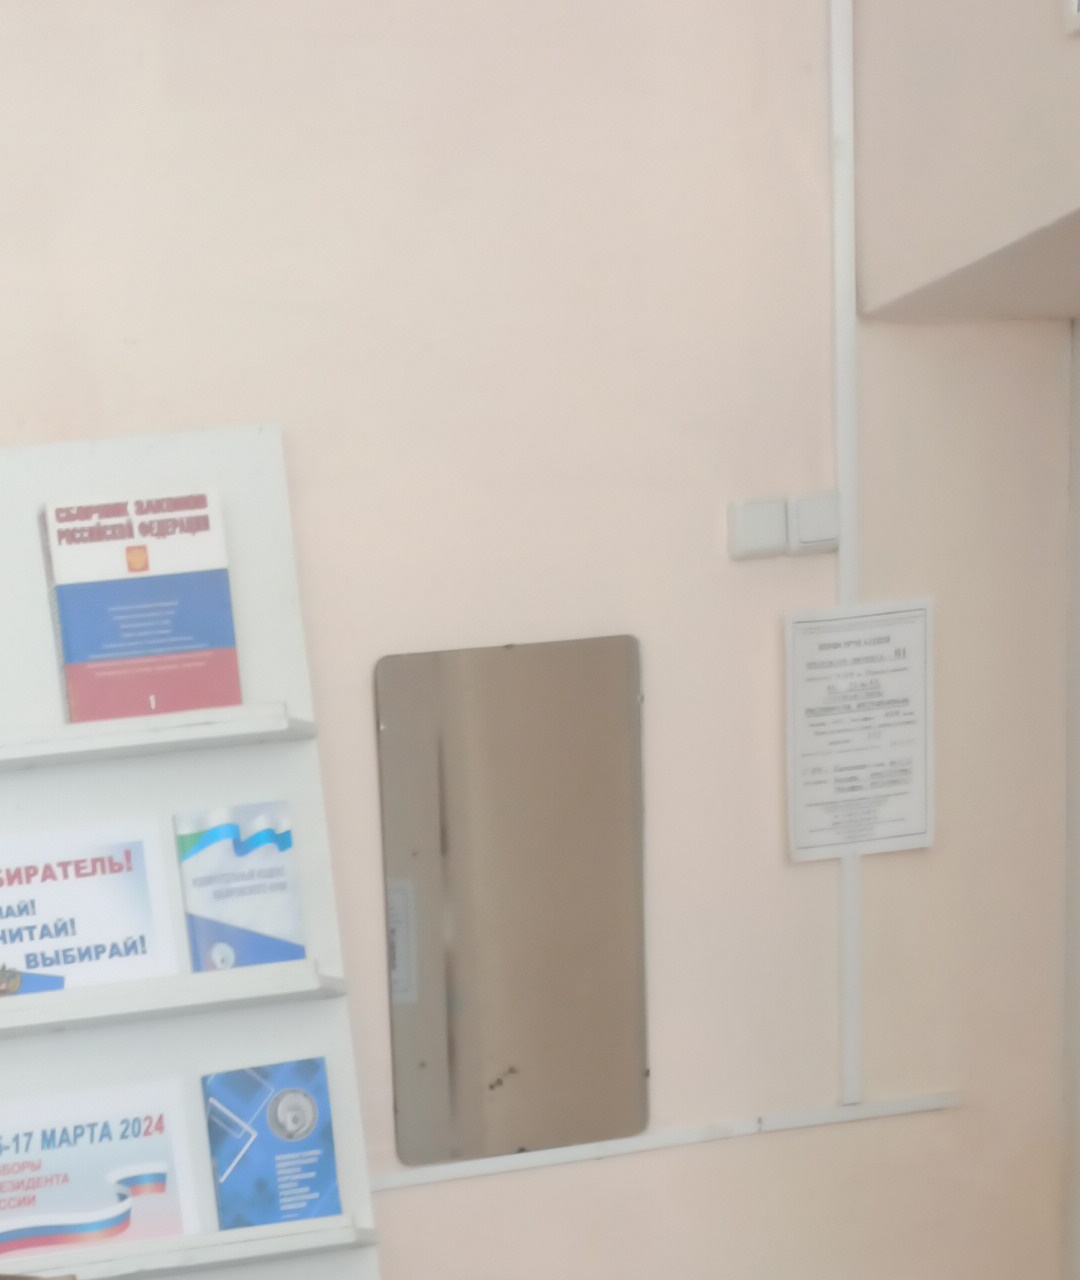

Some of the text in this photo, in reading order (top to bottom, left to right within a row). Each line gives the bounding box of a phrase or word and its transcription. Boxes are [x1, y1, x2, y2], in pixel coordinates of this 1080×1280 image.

[24, 935, 147, 969] ВЫБИРАЙ!
[41, 1121, 112, 1150] МАРТА
[120, 1113, 165, 1140] 2024
